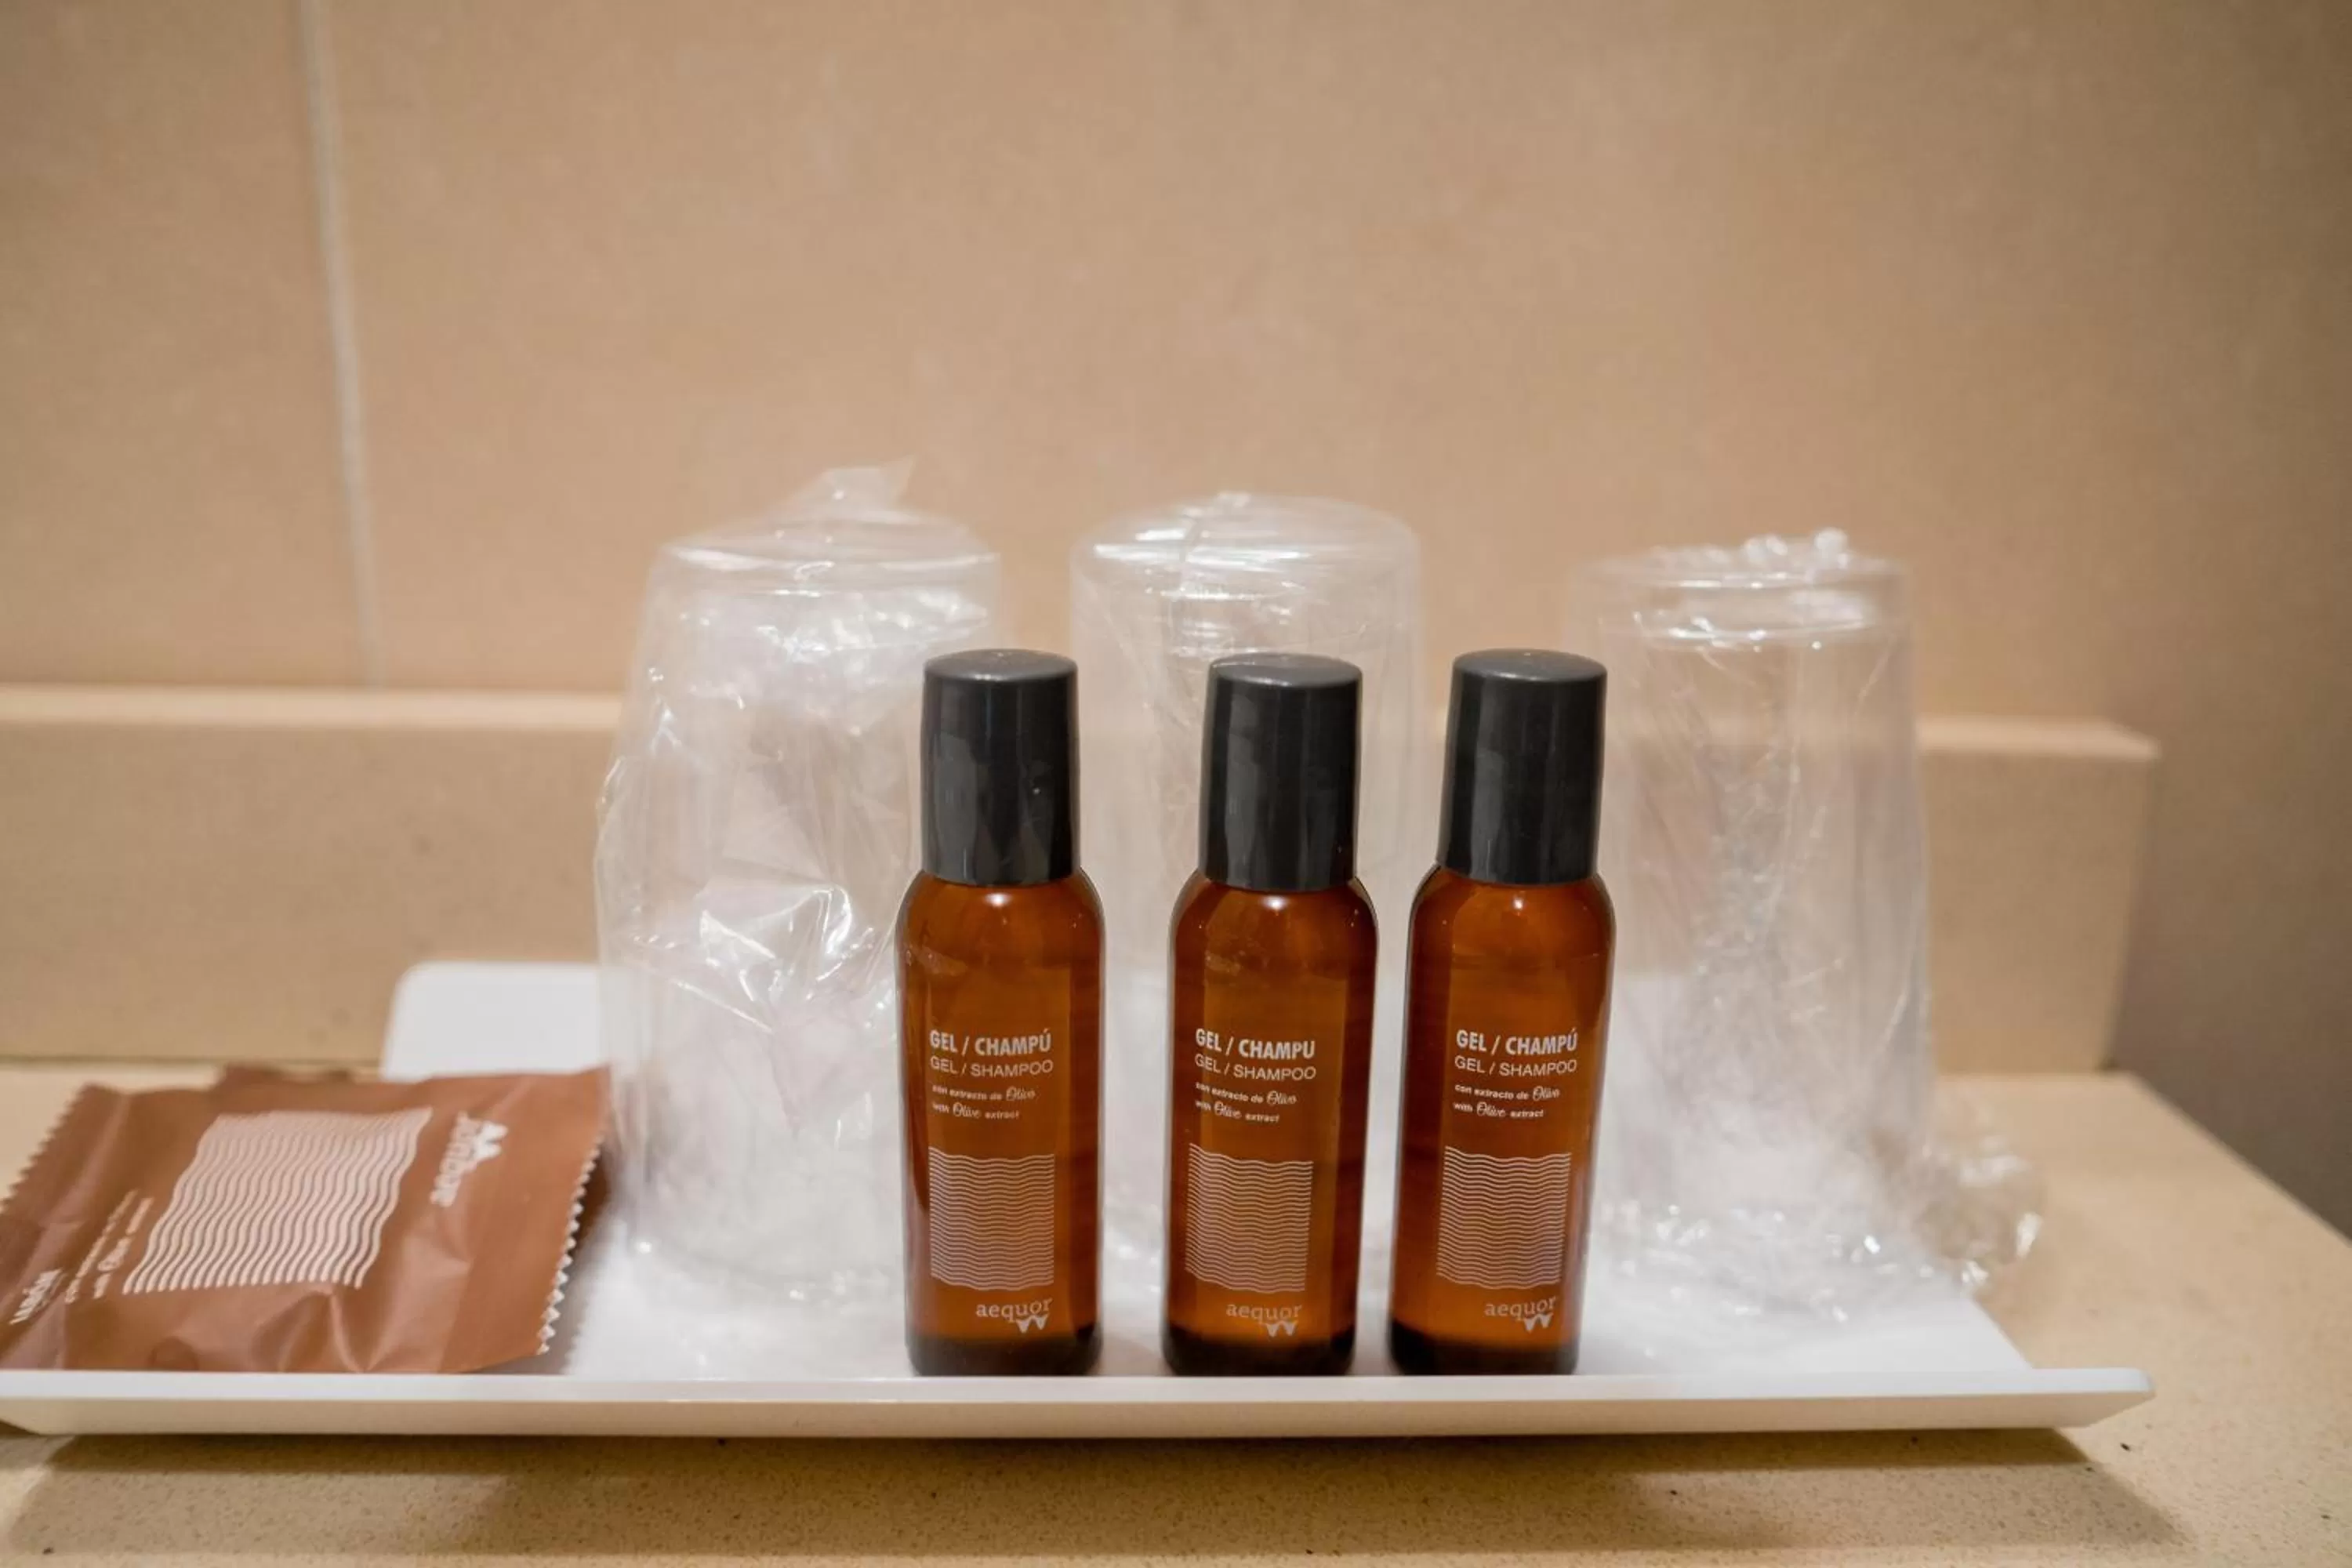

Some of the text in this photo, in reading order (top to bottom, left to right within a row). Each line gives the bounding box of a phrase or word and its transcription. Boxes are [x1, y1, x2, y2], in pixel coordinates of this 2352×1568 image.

[930, 1029, 957, 1053] GEL
[975, 1028, 1052, 1056] CHAMPÚ
[1196, 1028, 1222, 1051] GEL
[1456, 1029, 1487, 1052] GEL
[1505, 1027, 1578, 1055] CHAMPÚ
[931, 1055, 957, 1075] GEL
[971, 1059, 1054, 1078] SHAMPOO
[1195, 1053, 1221, 1074] GEL
[1233, 1064, 1317, 1082] SHAMPOO
[1454, 1054, 1486, 1074] GEL
[1498, 1059, 1577, 1078] SHAMPOO
[1211, 1087, 1249, 1102] extracto
[1474, 1088, 1514, 1100] extracto
[1516, 1091, 1530, 1100] de
[985, 1109, 1020, 1120] extract
[1245, 1112, 1280, 1123] extract
[1510, 1109, 1544, 1118] extract
[976, 1298, 1053, 1323] aequor
[1226, 1304, 1302, 1326] aequor
[1483, 1296, 1556, 1321] aequor
